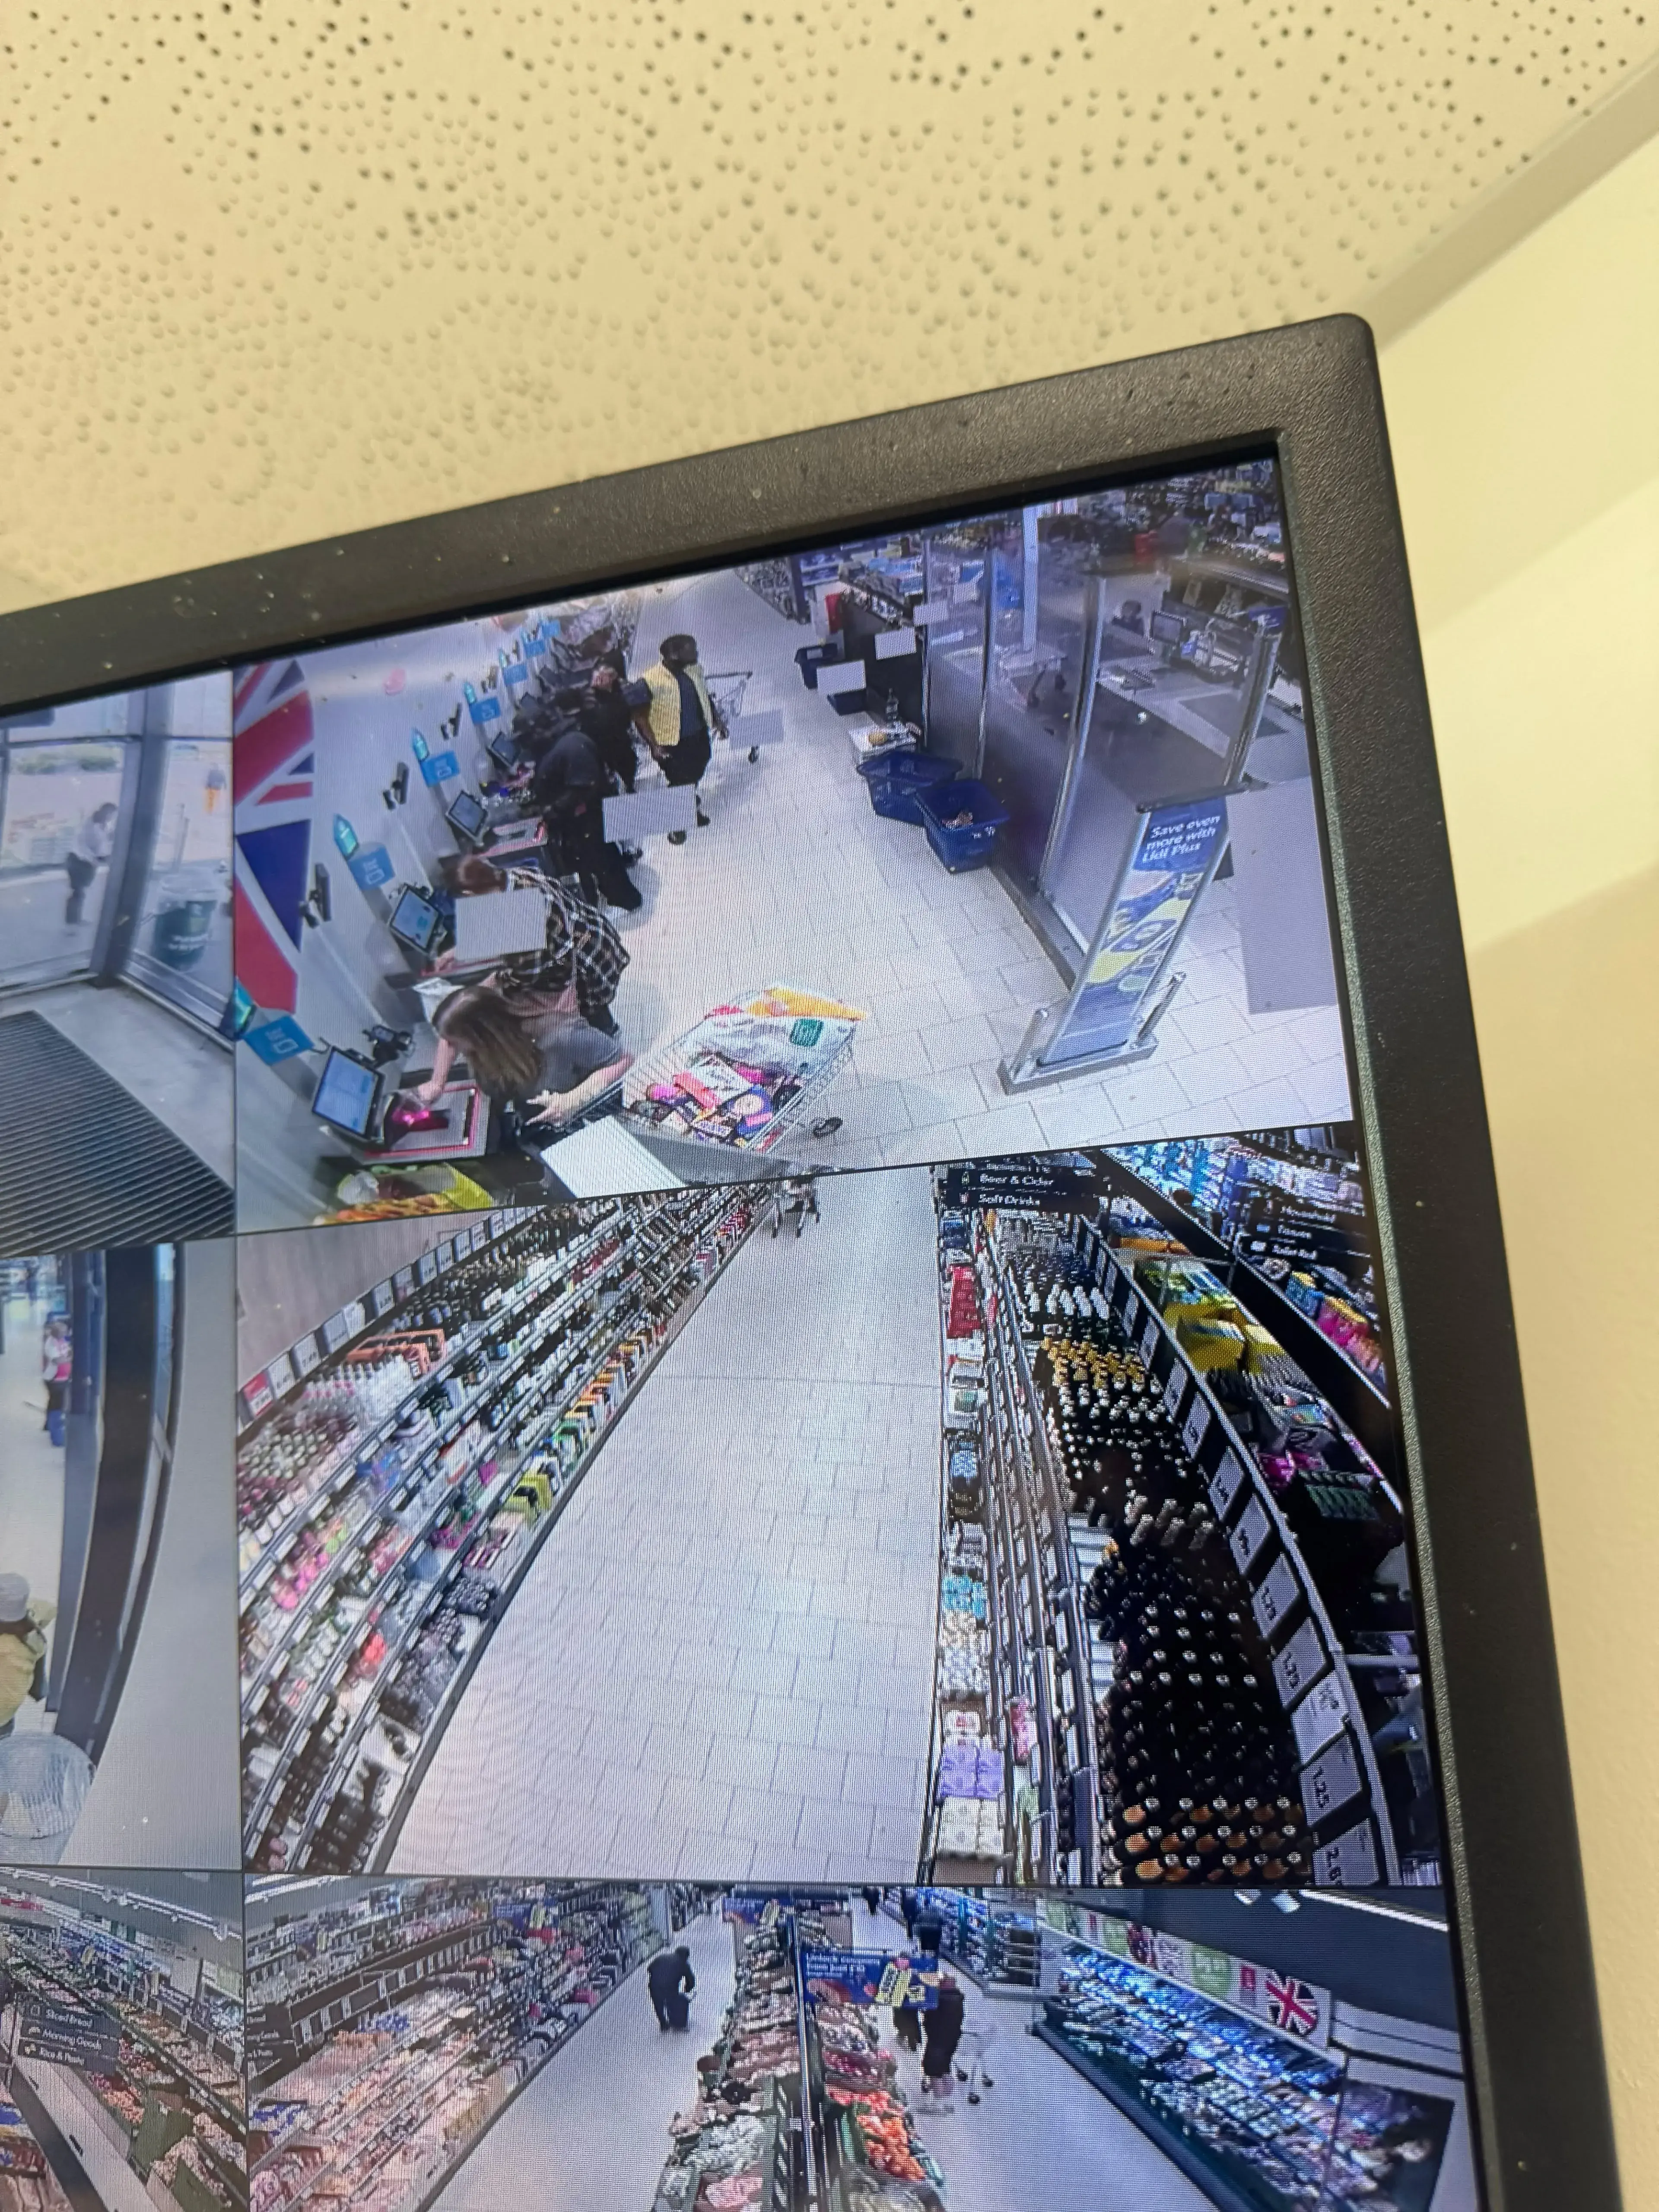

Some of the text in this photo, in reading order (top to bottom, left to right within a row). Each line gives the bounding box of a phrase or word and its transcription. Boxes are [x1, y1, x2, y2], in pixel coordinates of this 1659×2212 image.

[1151, 815, 1220, 838] Save even
[1147, 828, 1216, 850] more with
[1142, 843, 1201, 863] Lidl Plus
[1312, 1767, 1330, 1808] 1.25
